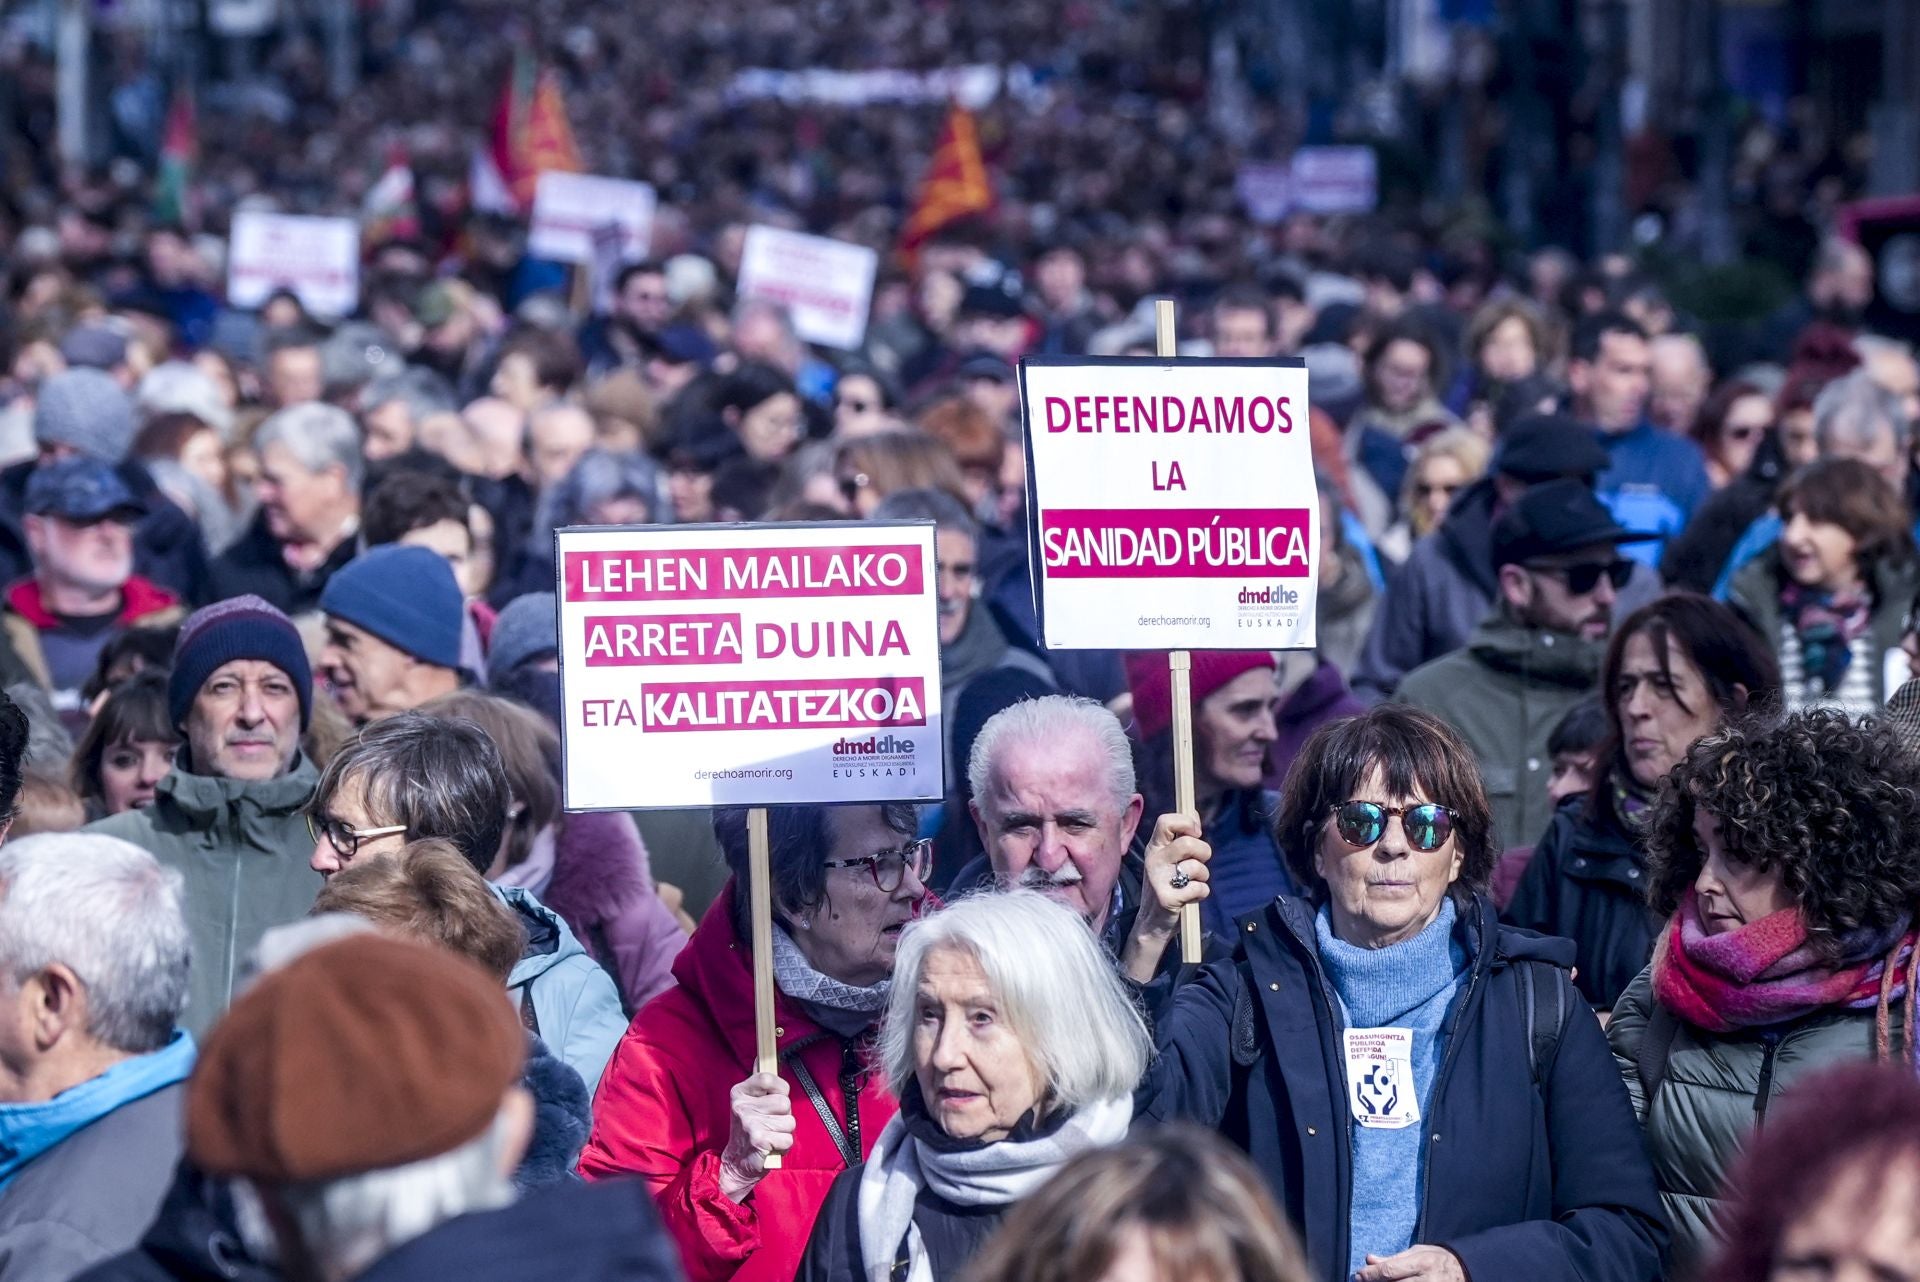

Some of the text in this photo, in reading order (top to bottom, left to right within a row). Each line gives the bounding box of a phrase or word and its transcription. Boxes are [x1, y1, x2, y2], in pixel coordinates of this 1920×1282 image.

[1045, 396, 1293, 434] DEFENDAMOS
[1151, 461, 1187, 491] LA
[1045, 515, 1309, 567] SANIDAD PÚBLICA
[581, 552, 908, 593] LEHEN MAILAKO
[1238, 584, 1298, 604] dmddhe
[1137, 614, 1211, 629] derechoamorir.org
[1238, 618, 1299, 628] EUSKADI
[585, 619, 911, 659] ARRETA DUINA
[582, 687, 923, 727] ETA KALITATEZKOA
[833, 735, 915, 755] dmddhe
[694, 767, 793, 780] derechoamorir.org
[833, 768, 916, 777] EUSKADI
